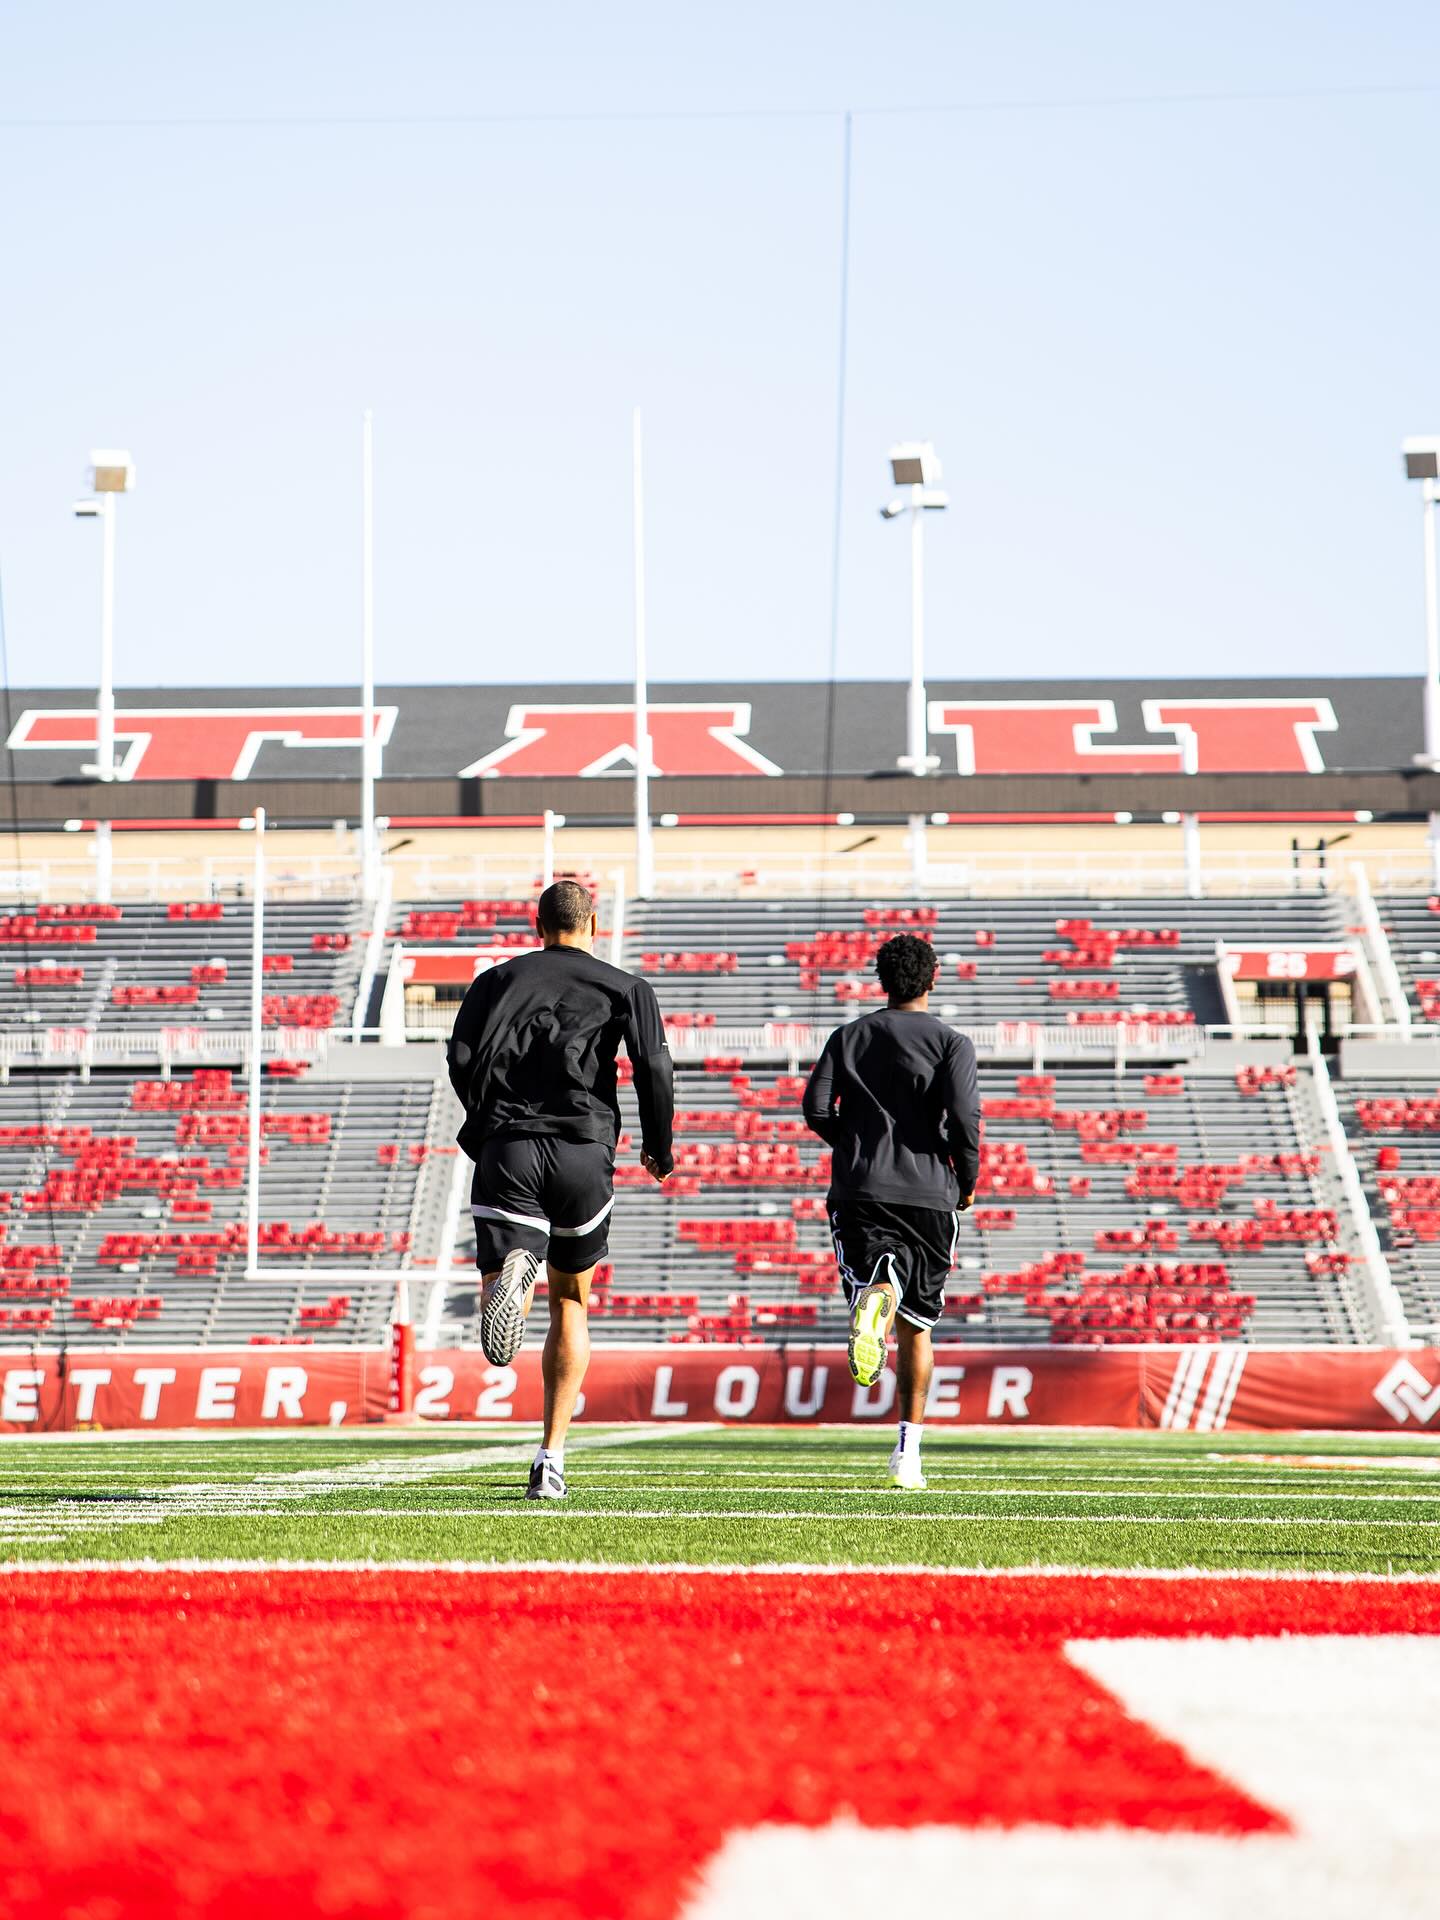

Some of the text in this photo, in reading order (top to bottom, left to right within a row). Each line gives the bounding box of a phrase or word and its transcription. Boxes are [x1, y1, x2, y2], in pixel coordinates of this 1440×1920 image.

[7, 698, 1338, 780] TAH
[2, 1365, 1034, 1427] ETTER, 22 LOUDER
